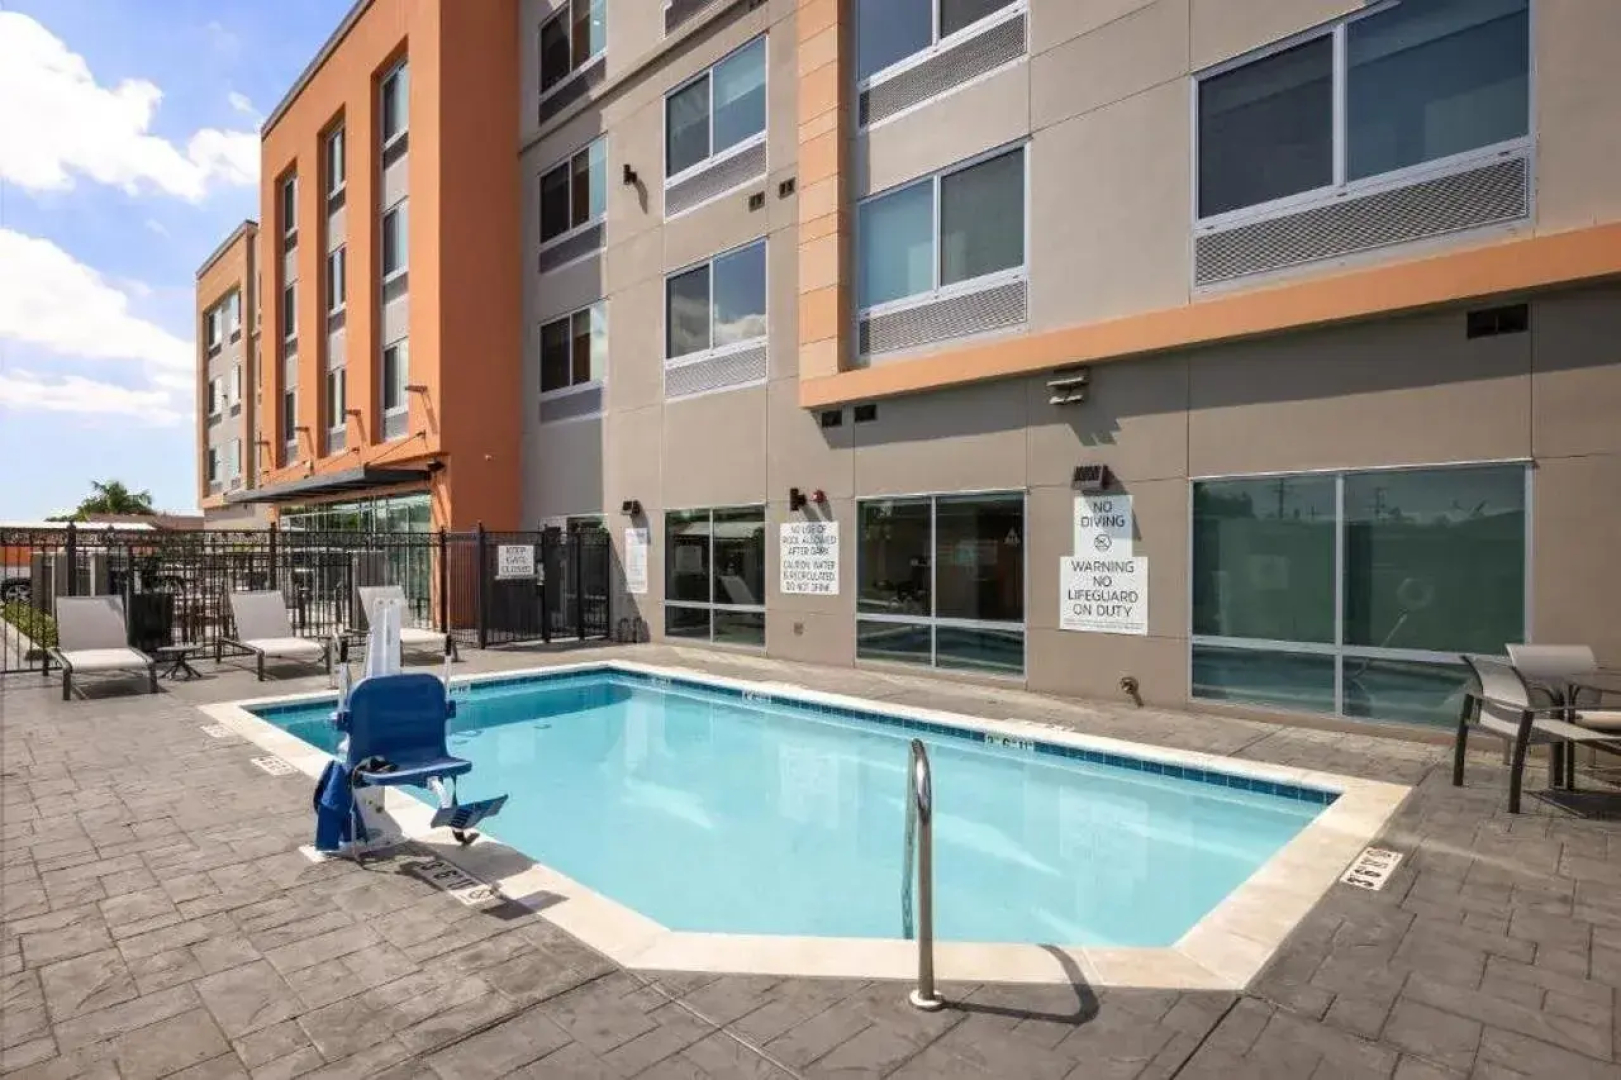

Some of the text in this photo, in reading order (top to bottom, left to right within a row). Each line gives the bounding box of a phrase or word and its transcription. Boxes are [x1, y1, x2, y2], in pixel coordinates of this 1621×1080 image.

[1093, 501, 1113, 513] NO
[1080, 515, 1126, 528] DIVING
[1071, 560, 1135, 573] WARNING
[1093, 575, 1113, 588] NO
[1068, 589, 1139, 604] LIFEGUARD
[1072, 603, 1133, 618] ON DUTY
